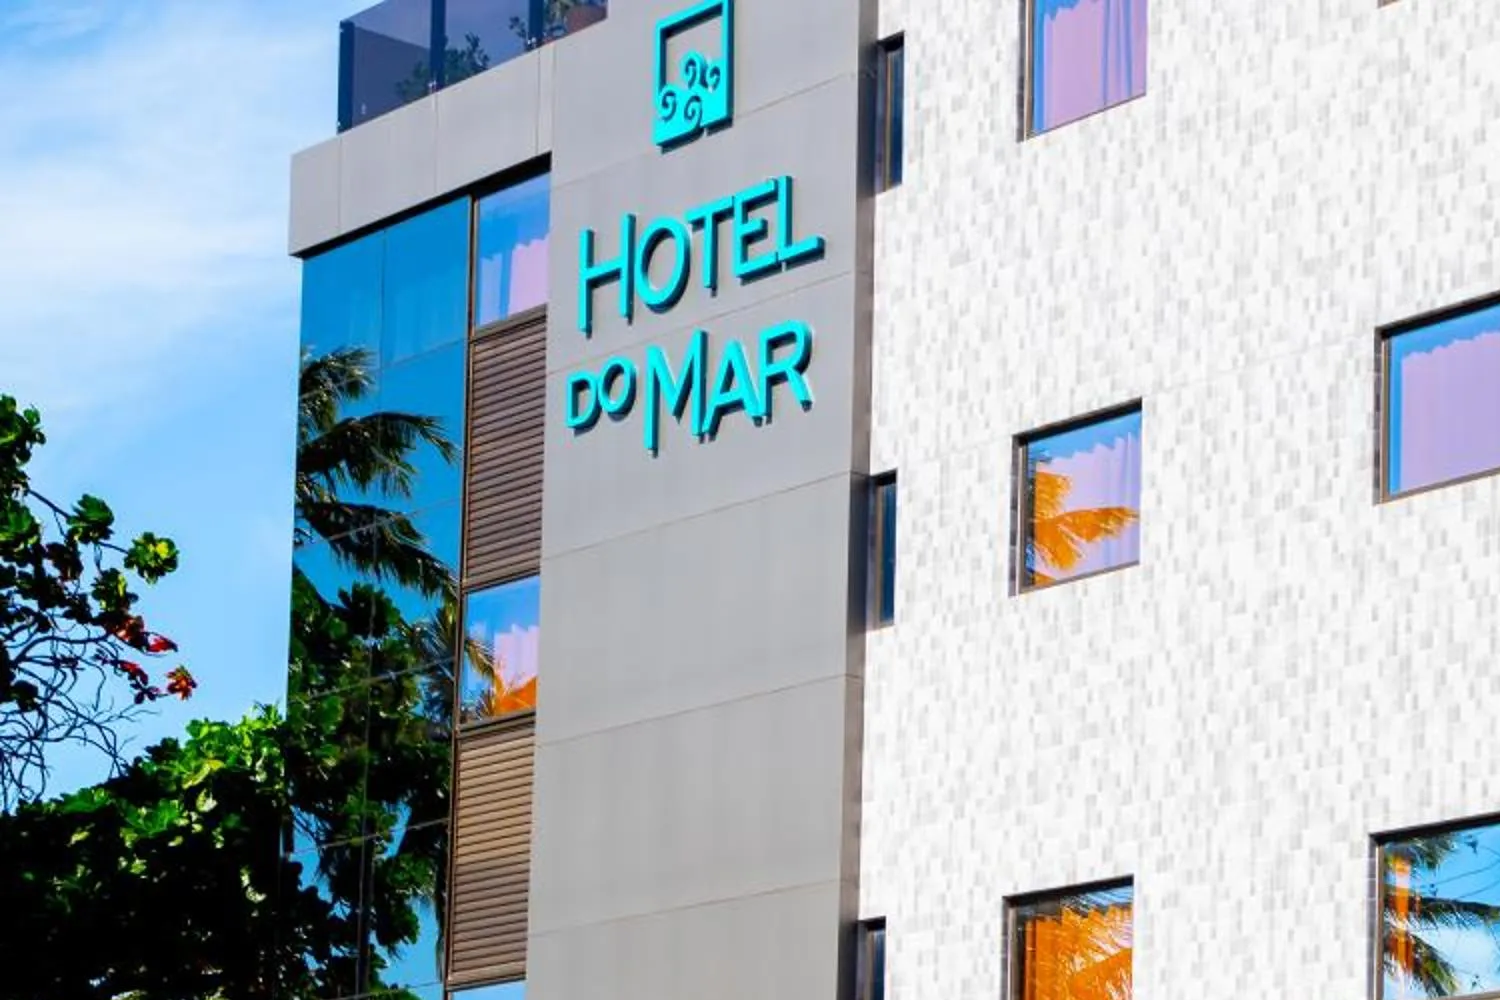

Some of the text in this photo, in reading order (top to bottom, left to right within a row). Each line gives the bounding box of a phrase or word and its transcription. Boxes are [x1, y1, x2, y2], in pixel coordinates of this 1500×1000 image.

[577, 174, 825, 335] HOTEL
[566, 319, 814, 450] DO MAR
